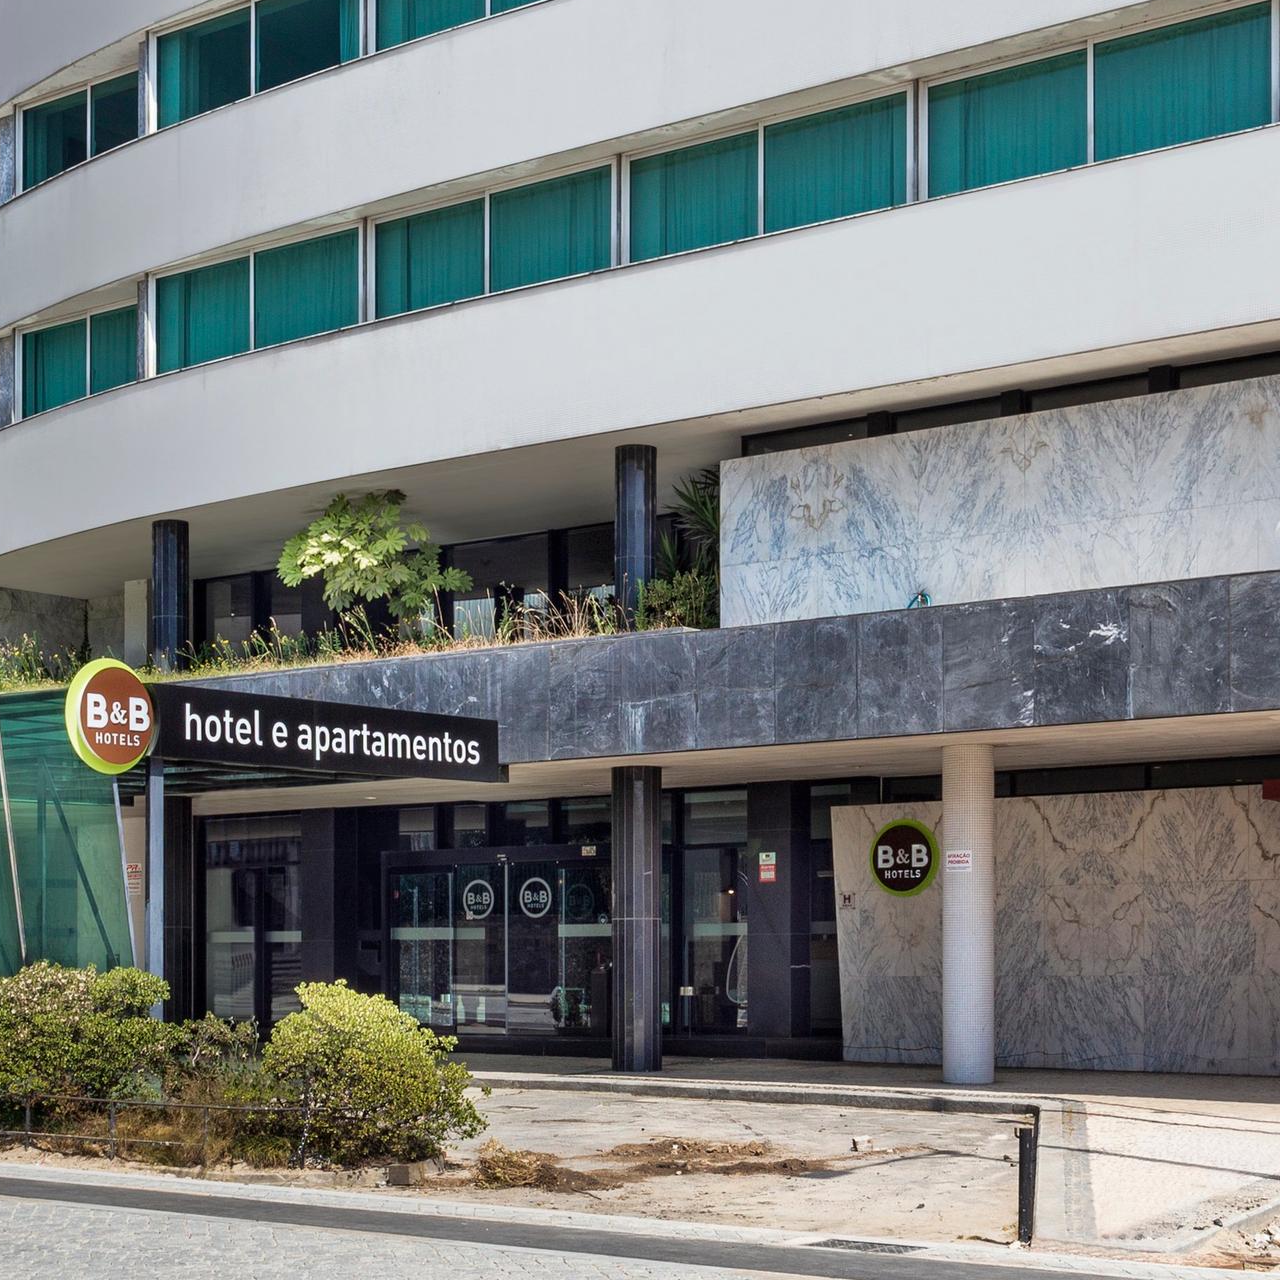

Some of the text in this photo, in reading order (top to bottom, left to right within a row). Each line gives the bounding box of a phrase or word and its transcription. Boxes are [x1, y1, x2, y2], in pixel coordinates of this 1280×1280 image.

[86, 692, 151, 732] B&B
[95, 731, 141, 747] HOTELS
[184, 703, 481, 766] hotel e apartamentos
[877, 844, 929, 869] B&B
[884, 869, 921, 879] HOTELS
[467, 892, 491, 905] B&B
[524, 890, 548, 904] B&B
